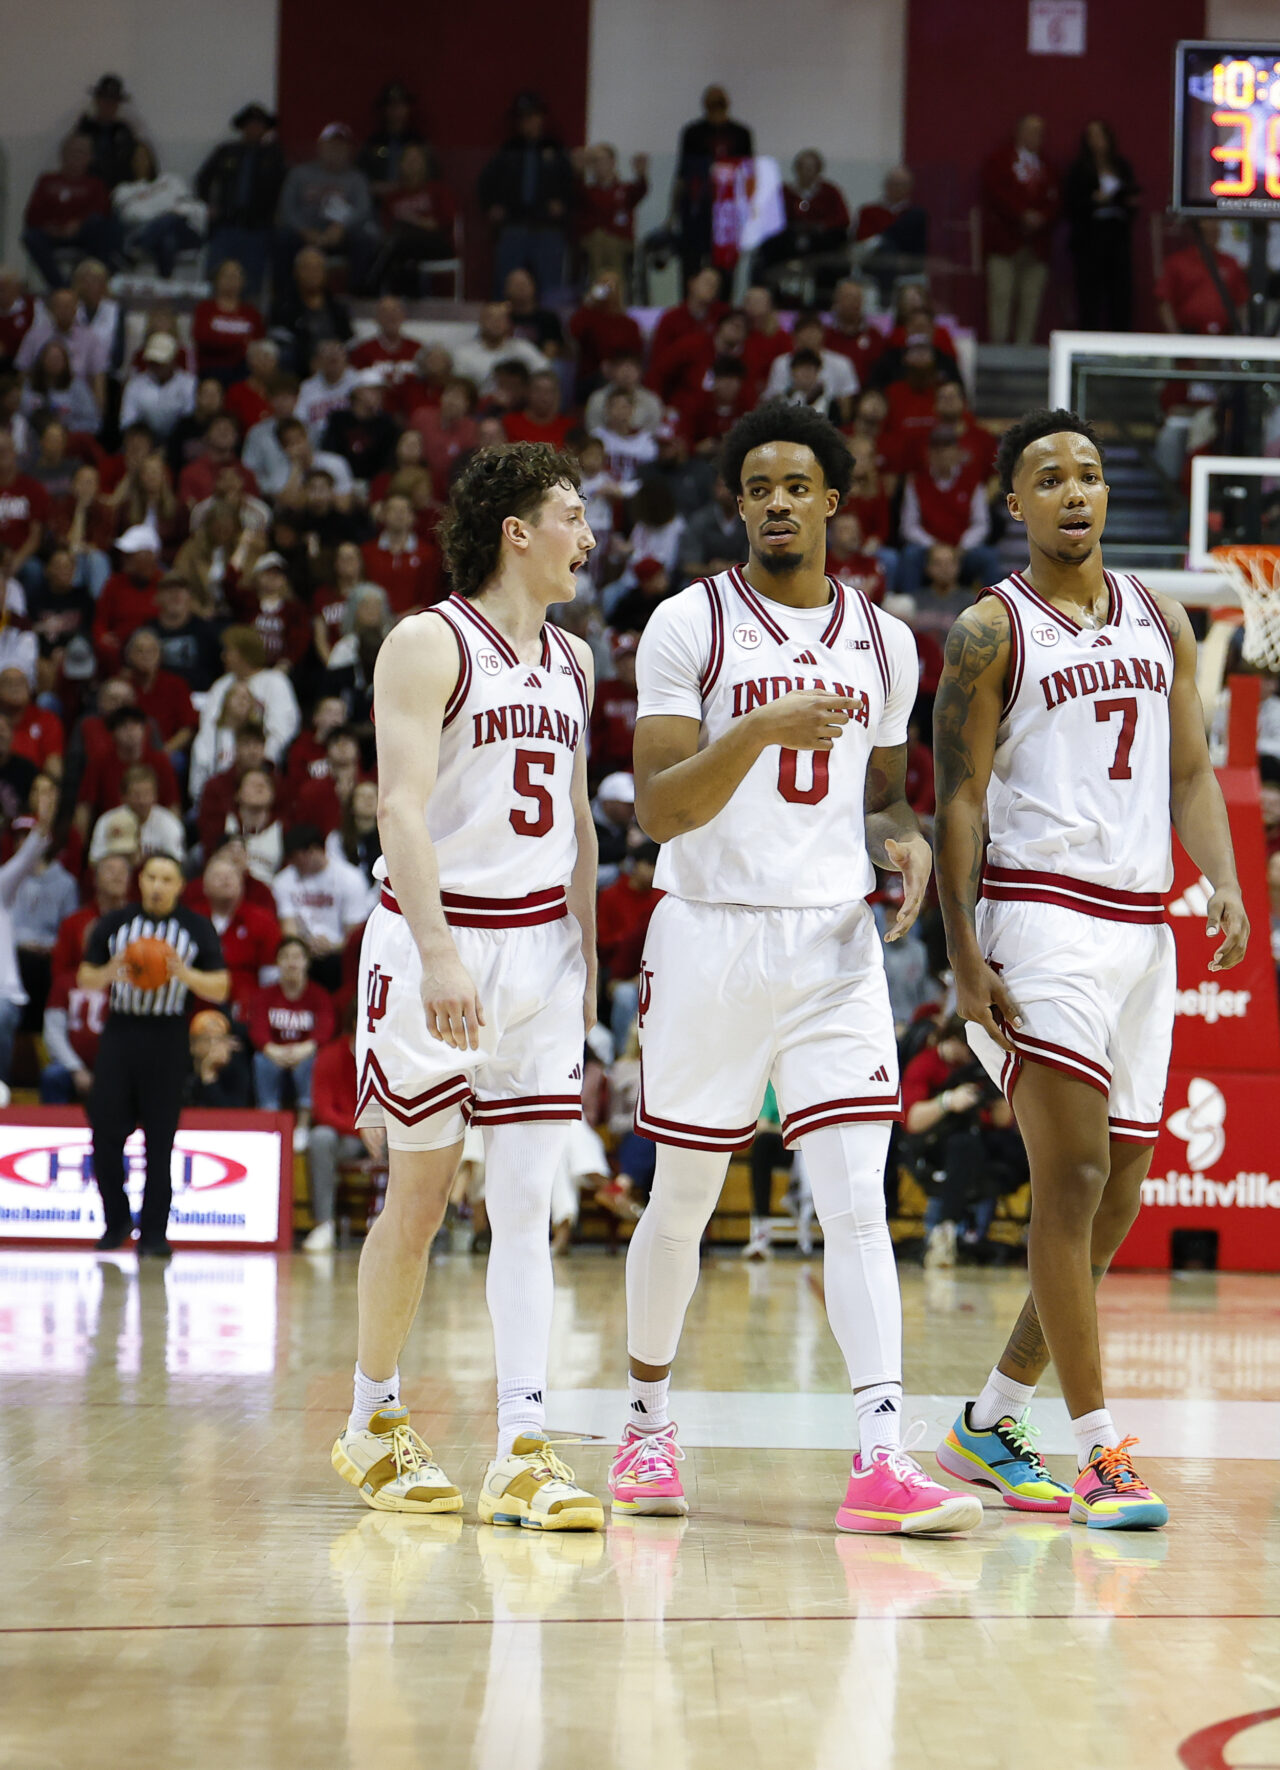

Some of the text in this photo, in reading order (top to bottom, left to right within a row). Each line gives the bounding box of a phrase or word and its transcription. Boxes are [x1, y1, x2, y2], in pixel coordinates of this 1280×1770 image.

[1039, 657, 1168, 711] INDIANA
[472, 703, 579, 753] INDIANA
[1093, 696, 1138, 780] 7
[509, 748, 555, 838] 5
